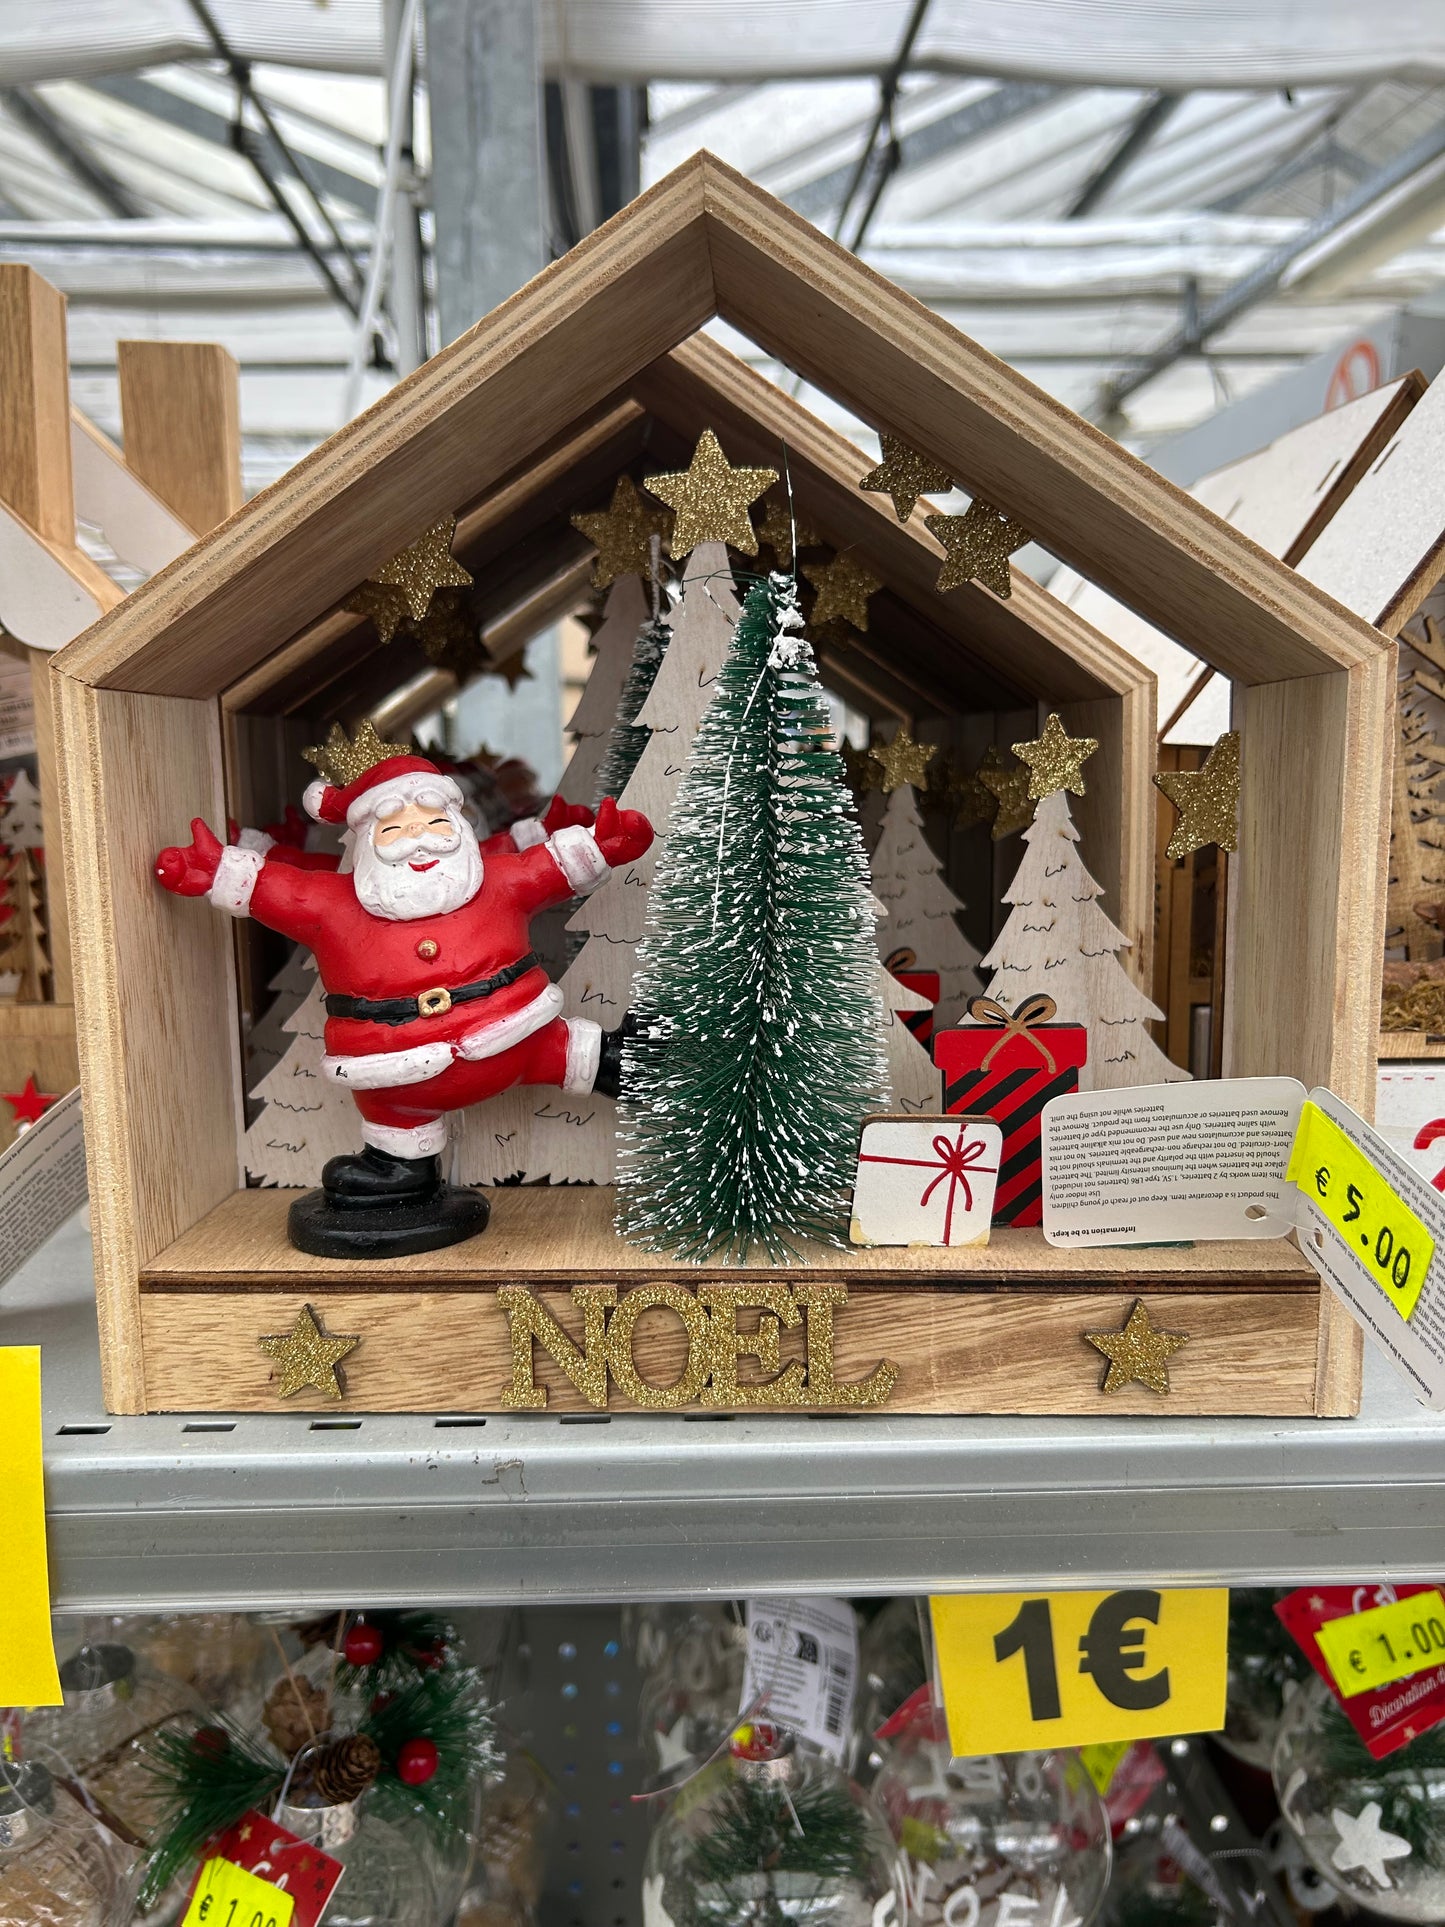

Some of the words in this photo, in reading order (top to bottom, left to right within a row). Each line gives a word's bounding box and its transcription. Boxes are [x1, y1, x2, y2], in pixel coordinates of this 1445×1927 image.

[1113, 1108, 1132, 1116] while
[1134, 1105, 1164, 1113] batteries
[1080, 1111, 1099, 1119] using
[1152, 1113, 1198, 1122] accumulators
[1091, 1118, 1120, 1128] product.
[1108, 1127, 1157, 1137] recommended
[1049, 1134, 1081, 1142] batteries.
[1049, 1144, 1079, 1152] batteries
[1080, 1141, 1107, 1149] alkaline
[1088, 1150, 1119, 1158] batteries.
[1121, 1145, 1181, 1155] non-rechargeable
[1157, 1153, 1184, 1162] polarity
[1072, 1162, 1095, 1170] should
[1096, 1159, 1128, 1167] terminals
[1095, 1170, 1119, 1178] limited.
[1219, 1171, 1228, 1179] by
[1097, 1177, 1129, 1186] (batteries
[1407, 1175, 1416, 1186] non
[1400, 1180, 1411, 1195] piles
[1417, 1184, 1423, 1193] de
[1238, 1191, 1264, 1199] product
[1080, 1198, 1101, 1206] young
[1307, 1205, 1315, 1215] des
[1050, 1230, 1069, 1238] kept.
[1091, 1226, 1136, 1235] Information
[1327, 1227, 1332, 1236] la
[1343, 1183, 1411, 1289] 5.00
[1327, 1266, 1332, 1274] et
[1332, 1272, 1353, 1300] utilisation
[1353, 1297, 1372, 1324] première
[1372, 1321, 1376, 1331] la
[1411, 1325, 1419, 1335] est
[1376, 1327, 1390, 1345] avant
[496, 1281, 900, 1409] NOEL
[1419, 1334, 1437, 1356] produit
[1401, 1357, 1432, 1398] Informations
[1377, 1617, 1445, 1663] 1.00
[993, 1589, 1170, 1721] 1€
